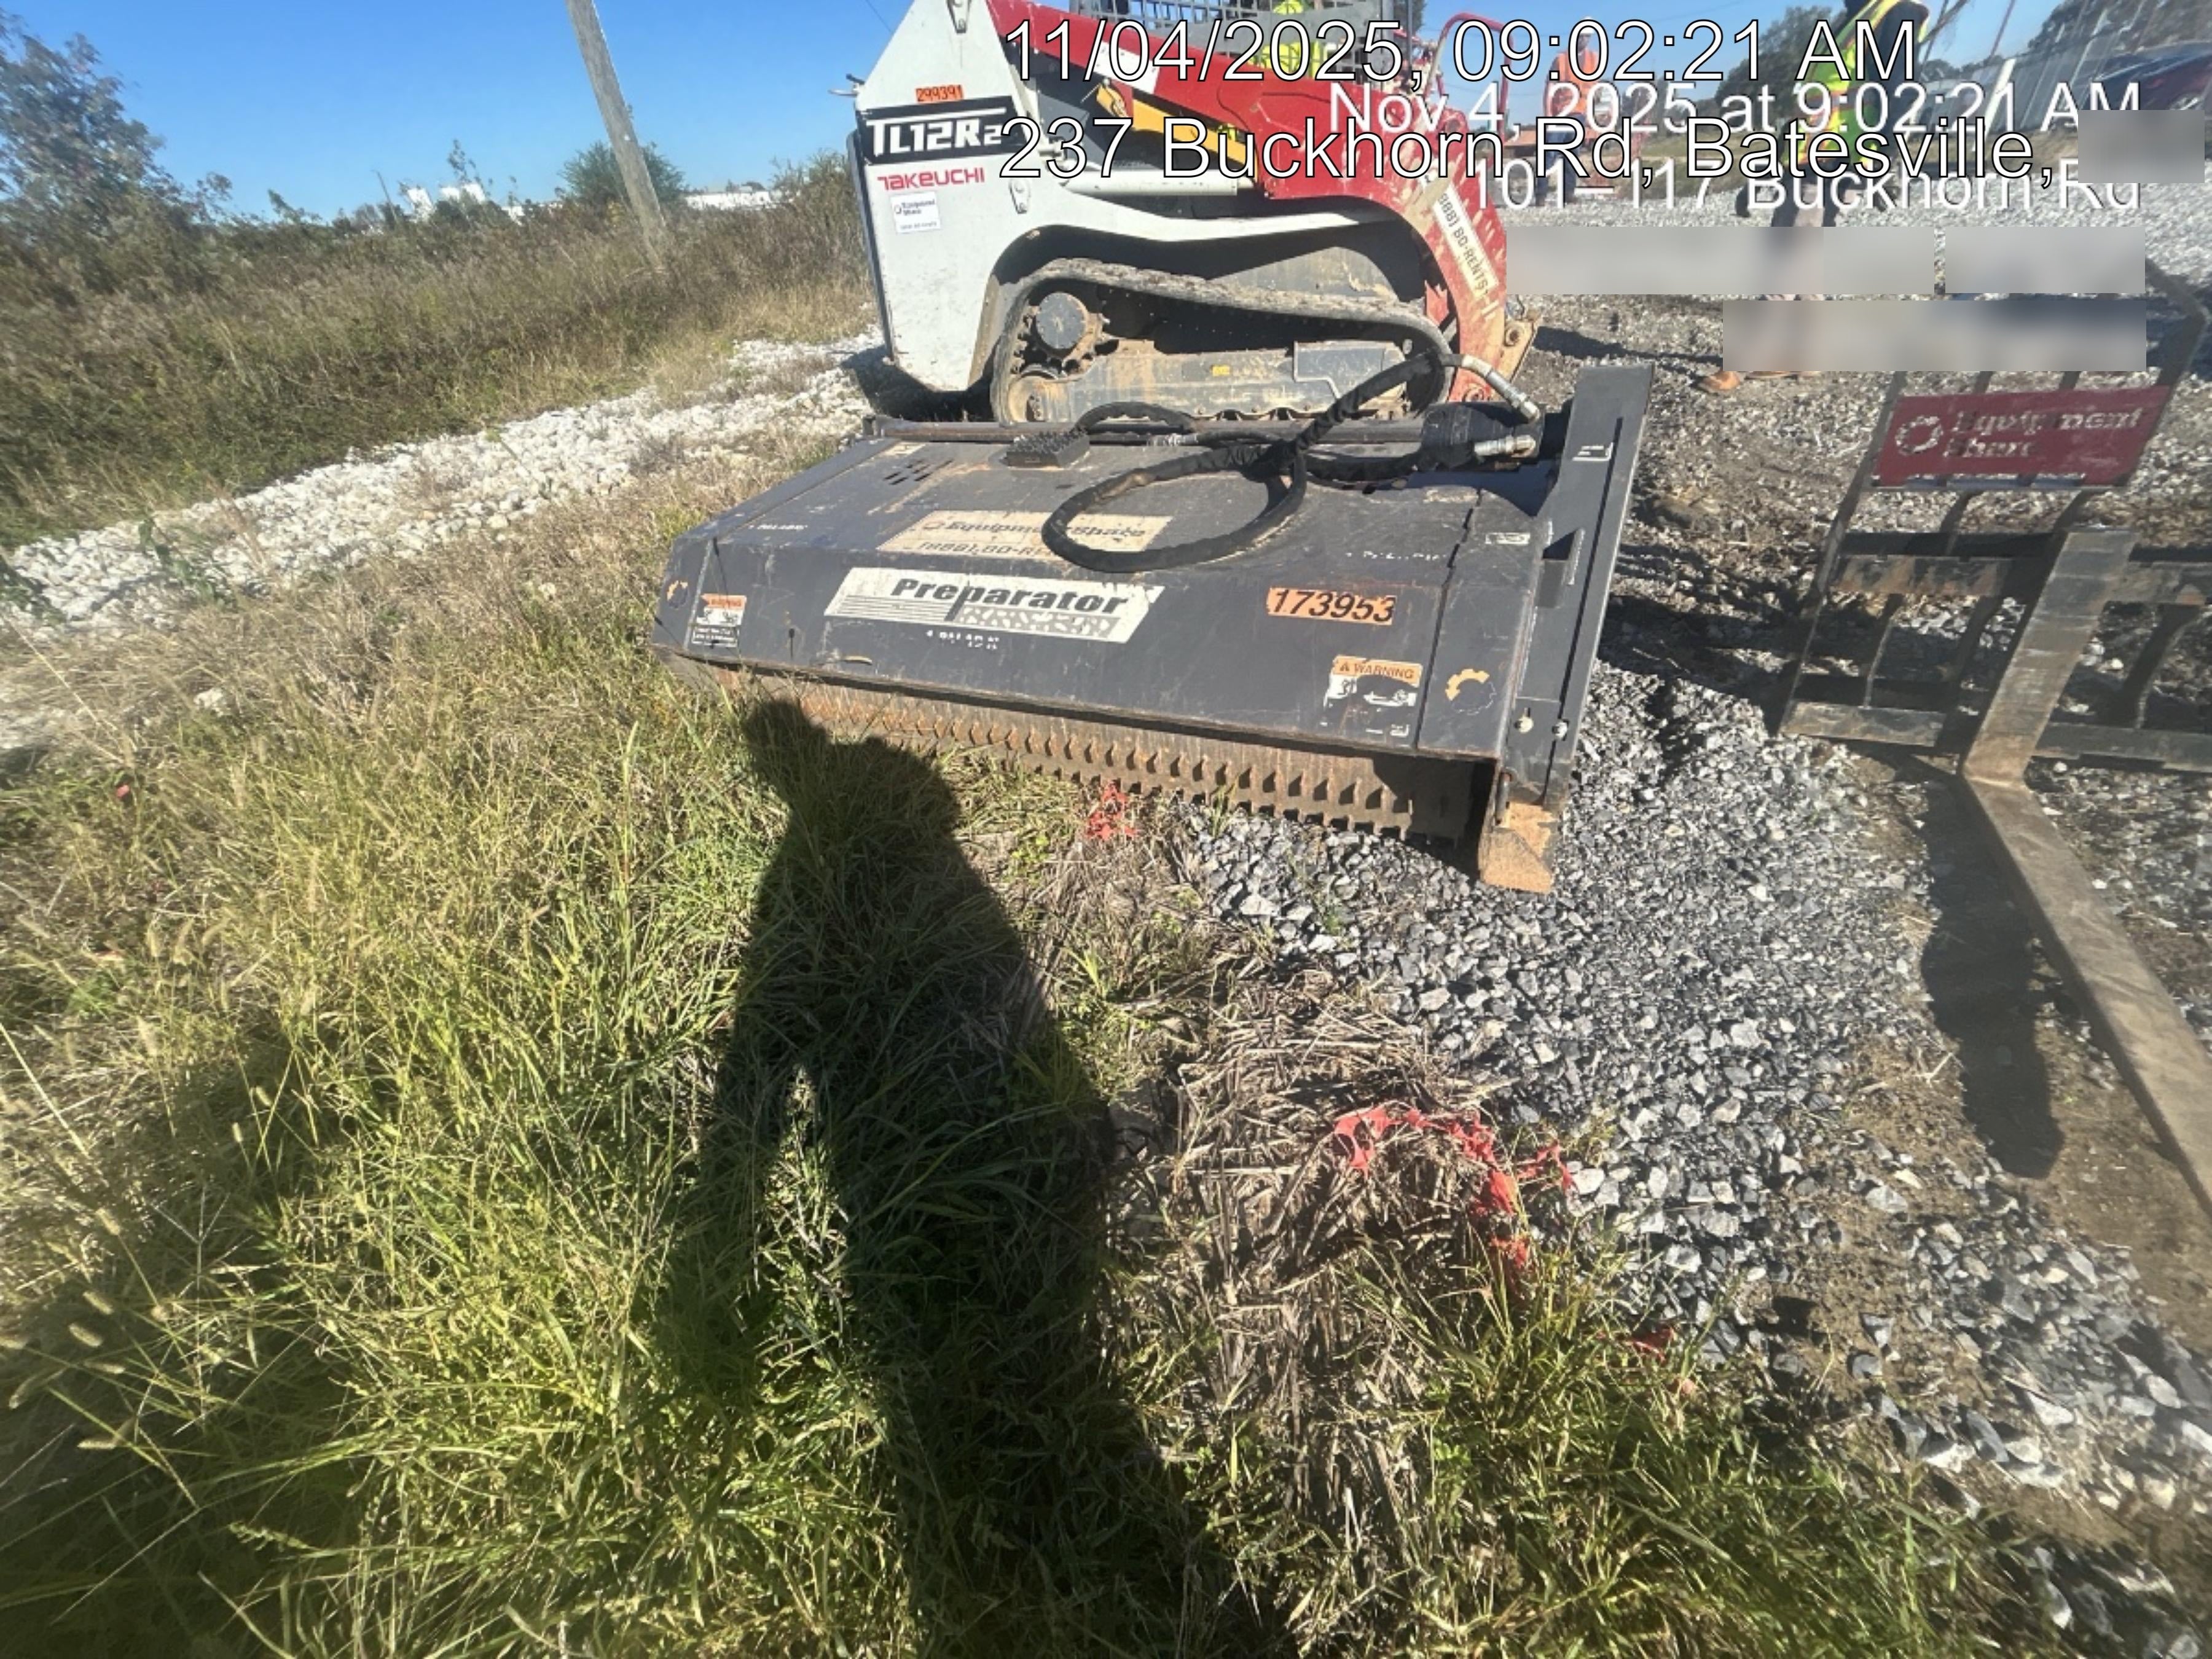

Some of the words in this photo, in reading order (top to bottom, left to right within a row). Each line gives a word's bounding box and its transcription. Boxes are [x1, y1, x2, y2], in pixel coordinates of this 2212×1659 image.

[917, 85, 962, 102] 299391
[890, 578, 1129, 622] Preparator
[1273, 589, 1395, 622] 173953
[1354, 662, 1414, 679] WARNING
